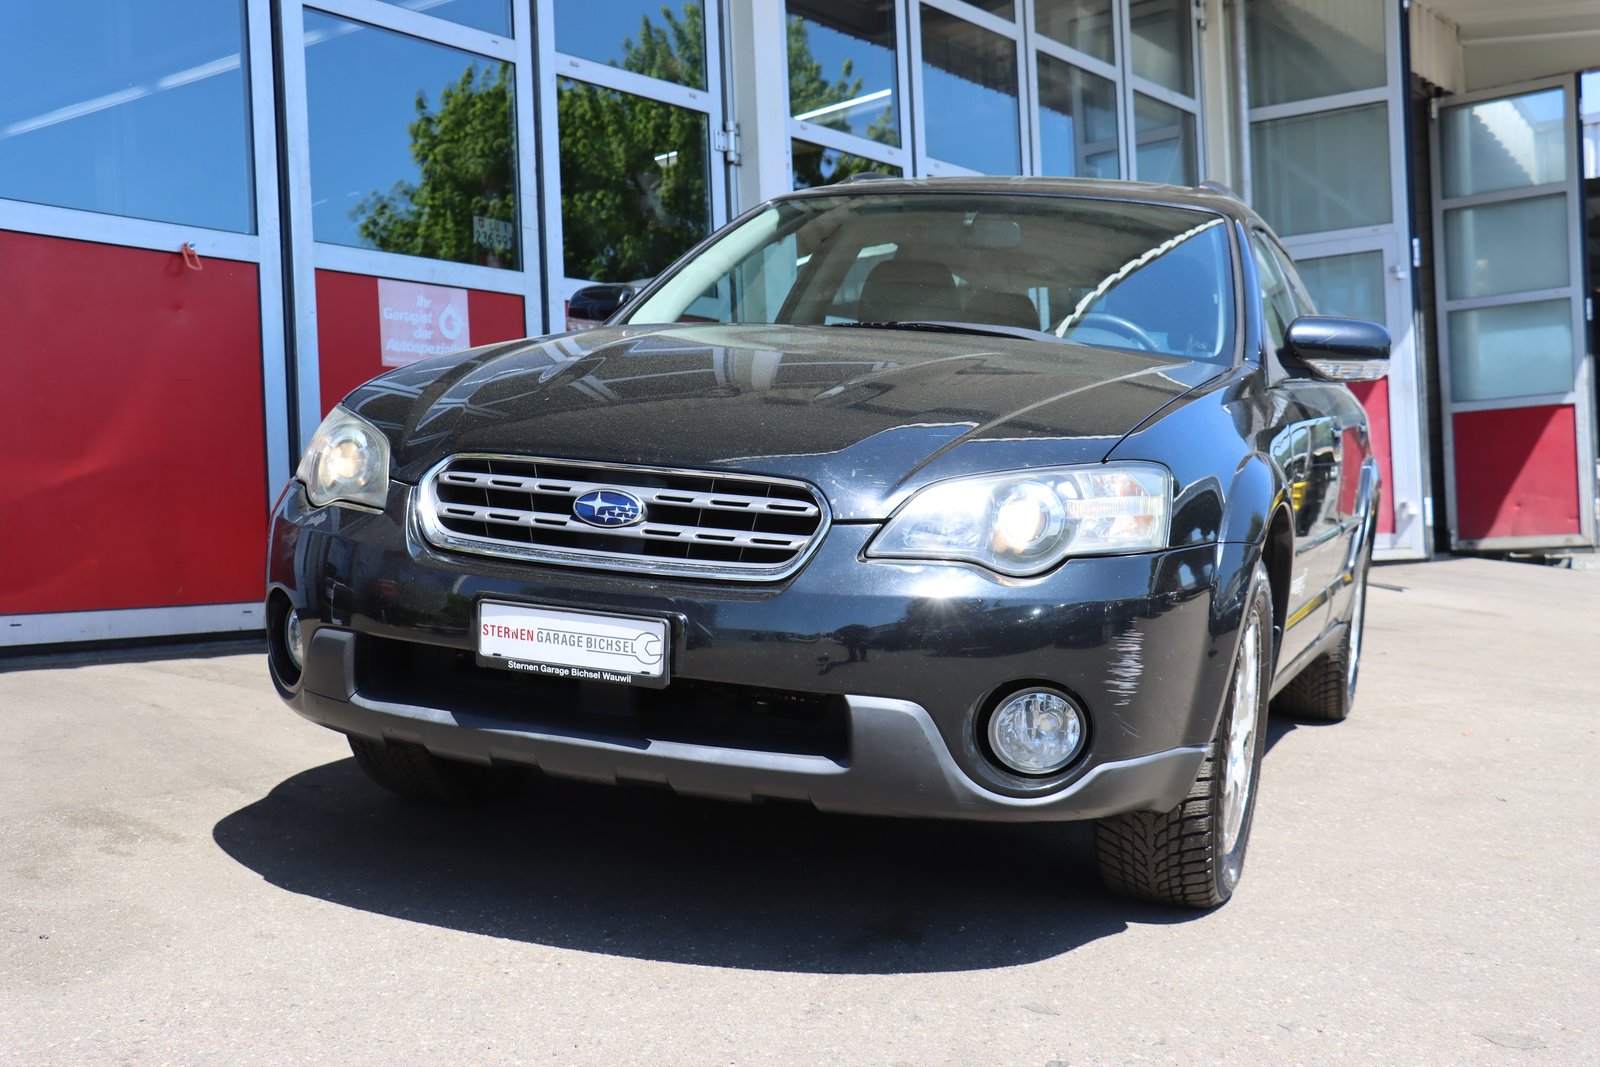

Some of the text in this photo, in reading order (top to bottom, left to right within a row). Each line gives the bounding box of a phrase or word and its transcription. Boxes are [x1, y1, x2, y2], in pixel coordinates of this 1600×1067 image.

[416, 295, 432, 308] Ihr
[383, 307, 432, 325] Garagist
[413, 327, 433, 340] der
[537, 630, 583, 648] GARAGE
[586, 637, 636, 654] BICHSEL
[507, 660, 632, 683] Sternen Garage Bichsel Wauwil
